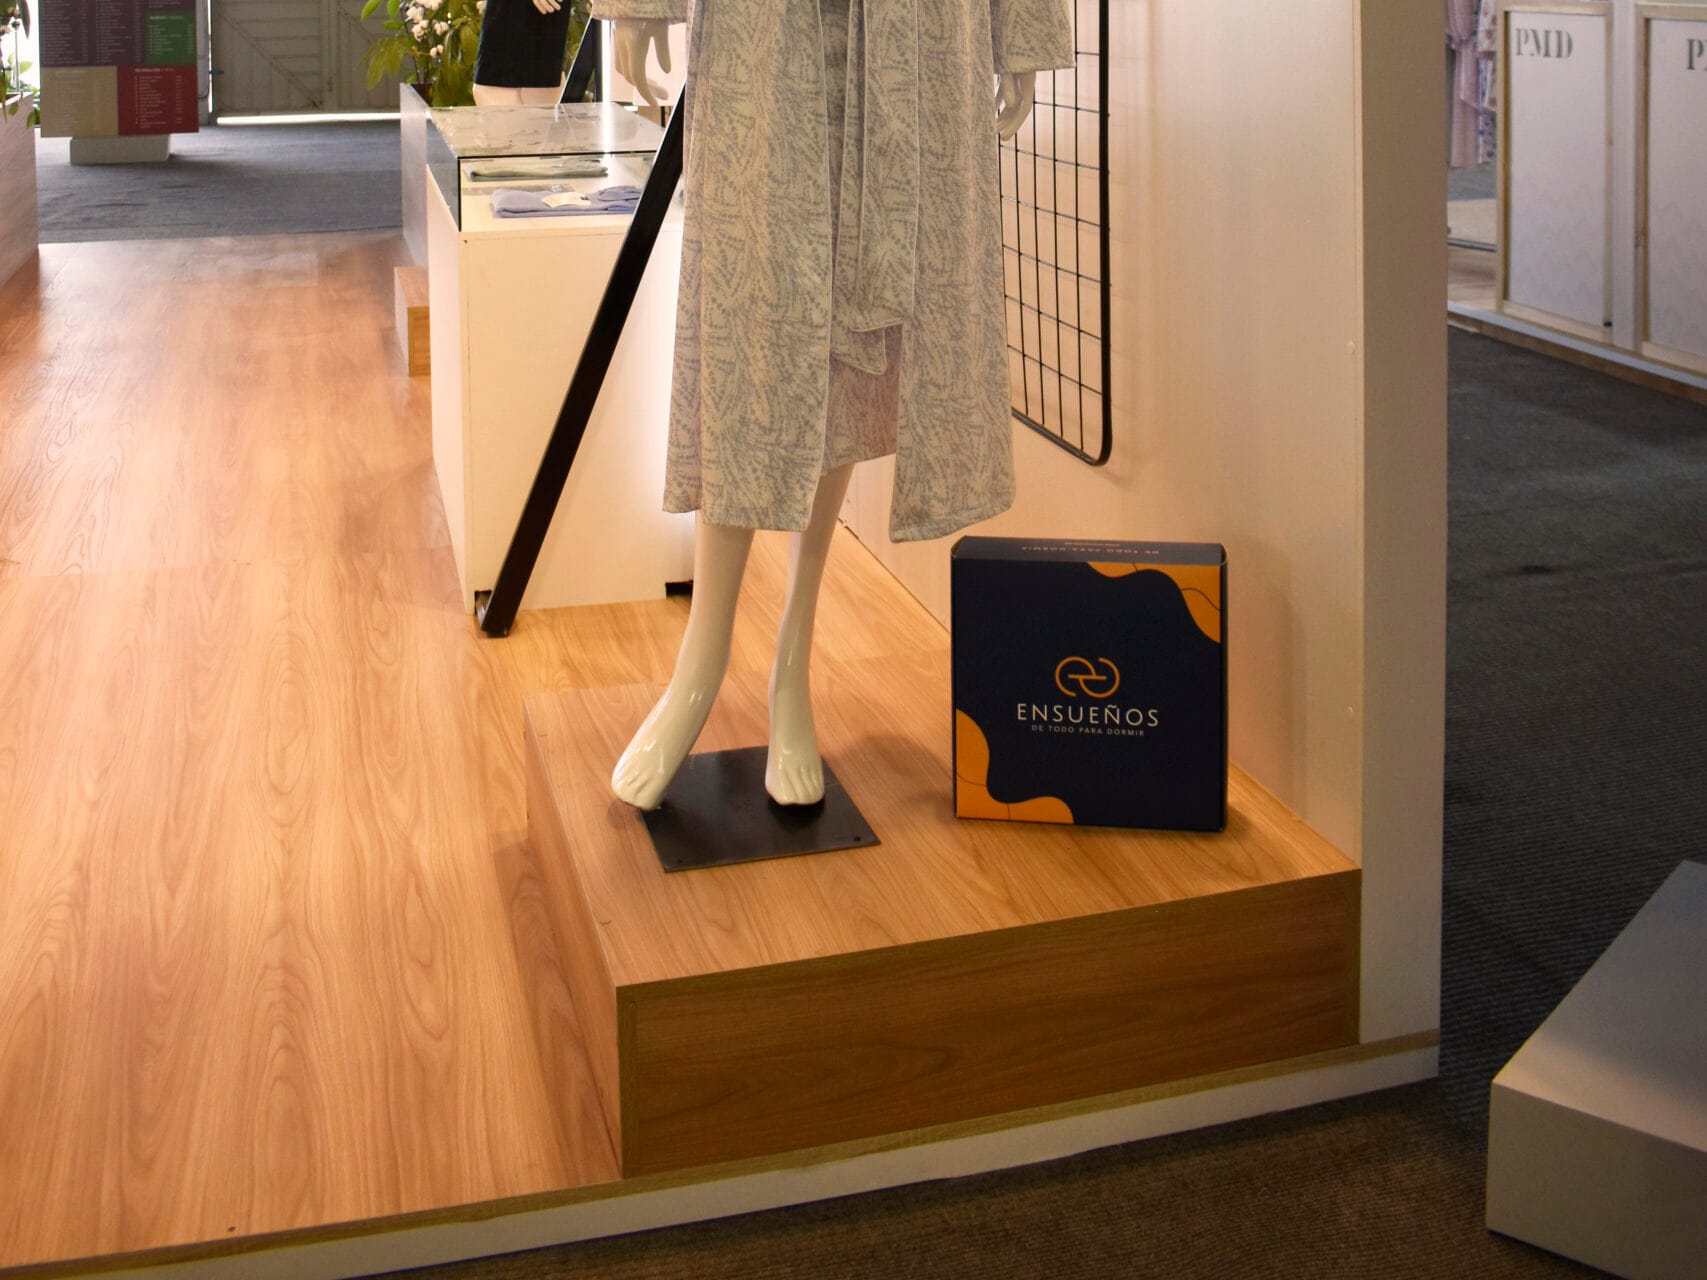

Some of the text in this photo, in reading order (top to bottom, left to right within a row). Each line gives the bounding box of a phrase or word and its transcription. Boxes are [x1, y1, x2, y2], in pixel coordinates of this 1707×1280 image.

[1515, 28, 1574, 59] PMD
[1017, 703, 1159, 727] ENSUEÑOS
[1031, 724, 1145, 737] DE TODO PARA DORMIR
